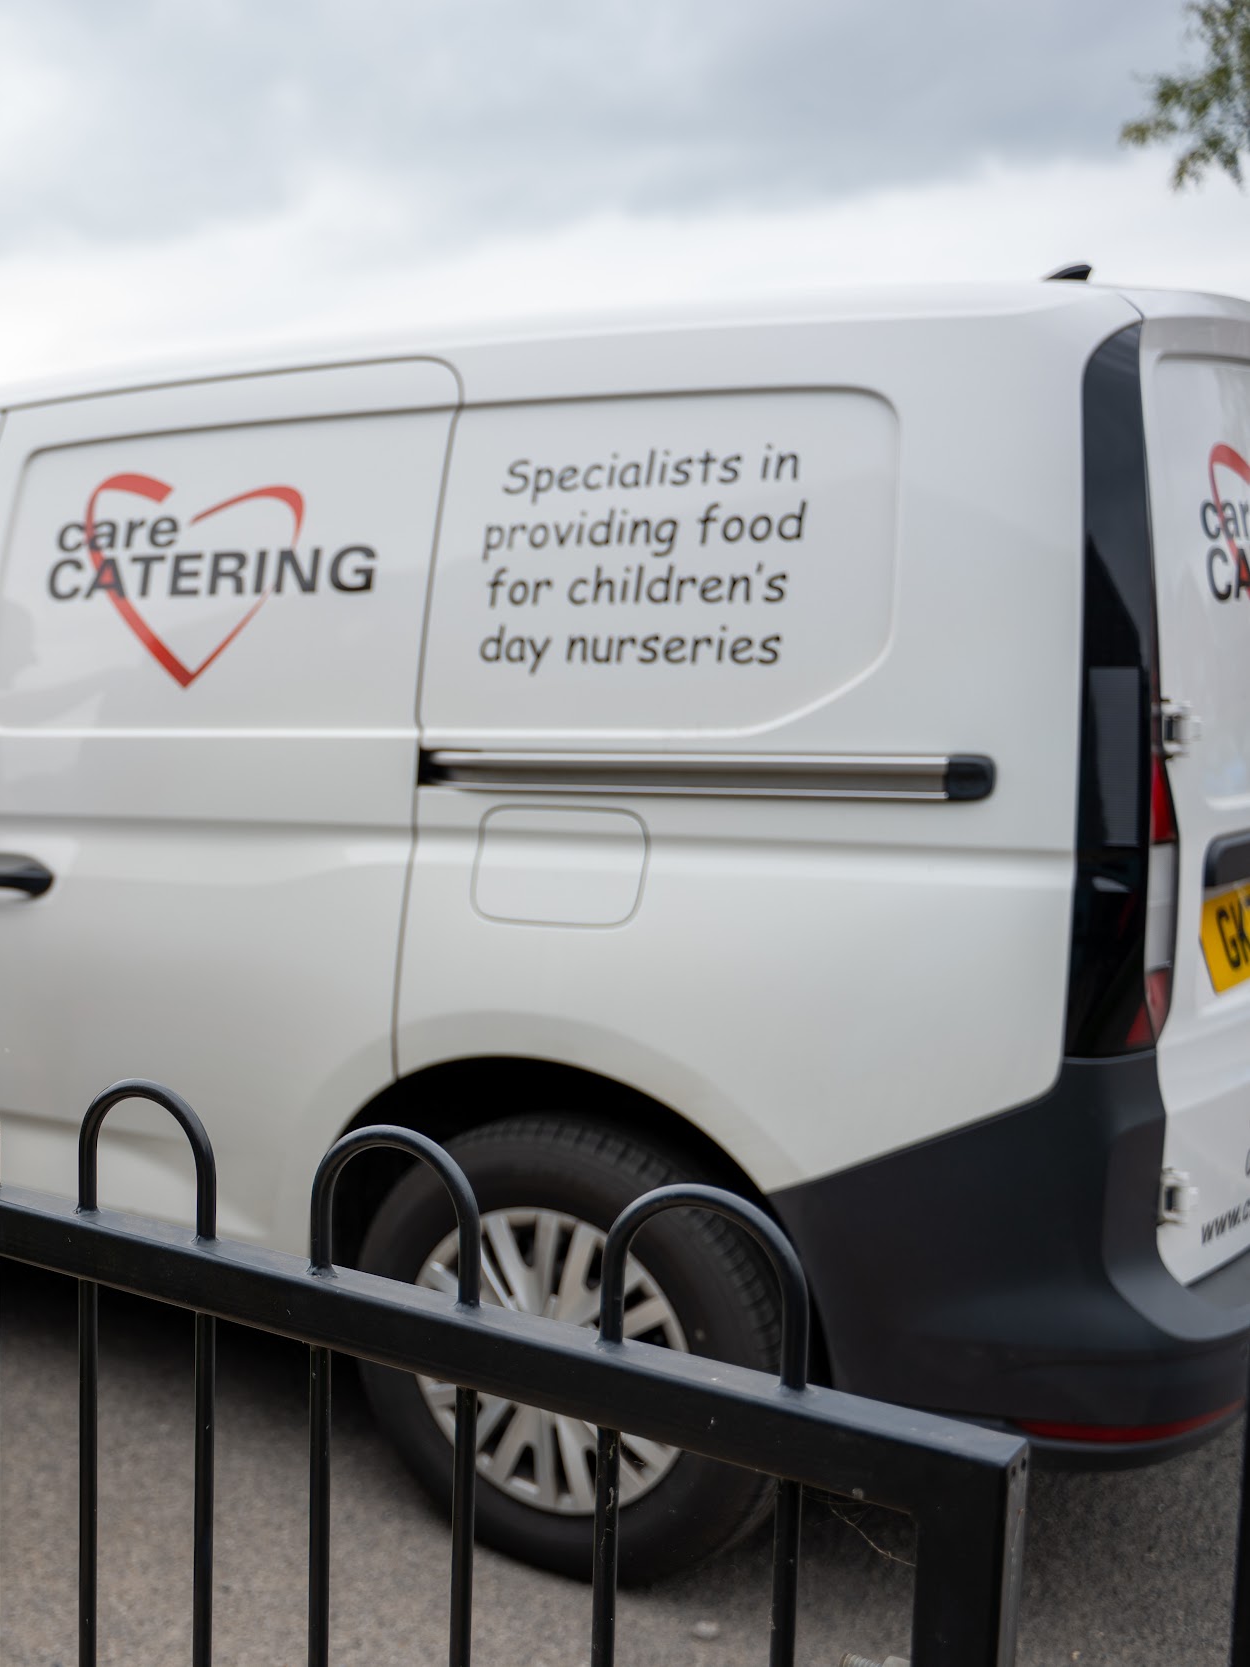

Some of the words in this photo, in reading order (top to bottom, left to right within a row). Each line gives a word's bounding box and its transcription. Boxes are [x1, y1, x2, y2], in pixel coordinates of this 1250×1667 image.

[502, 449, 743, 505] Specialists
[761, 443, 799, 482] in
[57, 515, 180, 553] care
[482, 508, 679, 563] providing
[698, 500, 807, 546] food
[48, 544, 378, 600] CATERING
[487, 567, 554, 609] for
[567, 562, 788, 606] children's
[480, 625, 551, 676] day
[566, 625, 782, 666] nurseries
